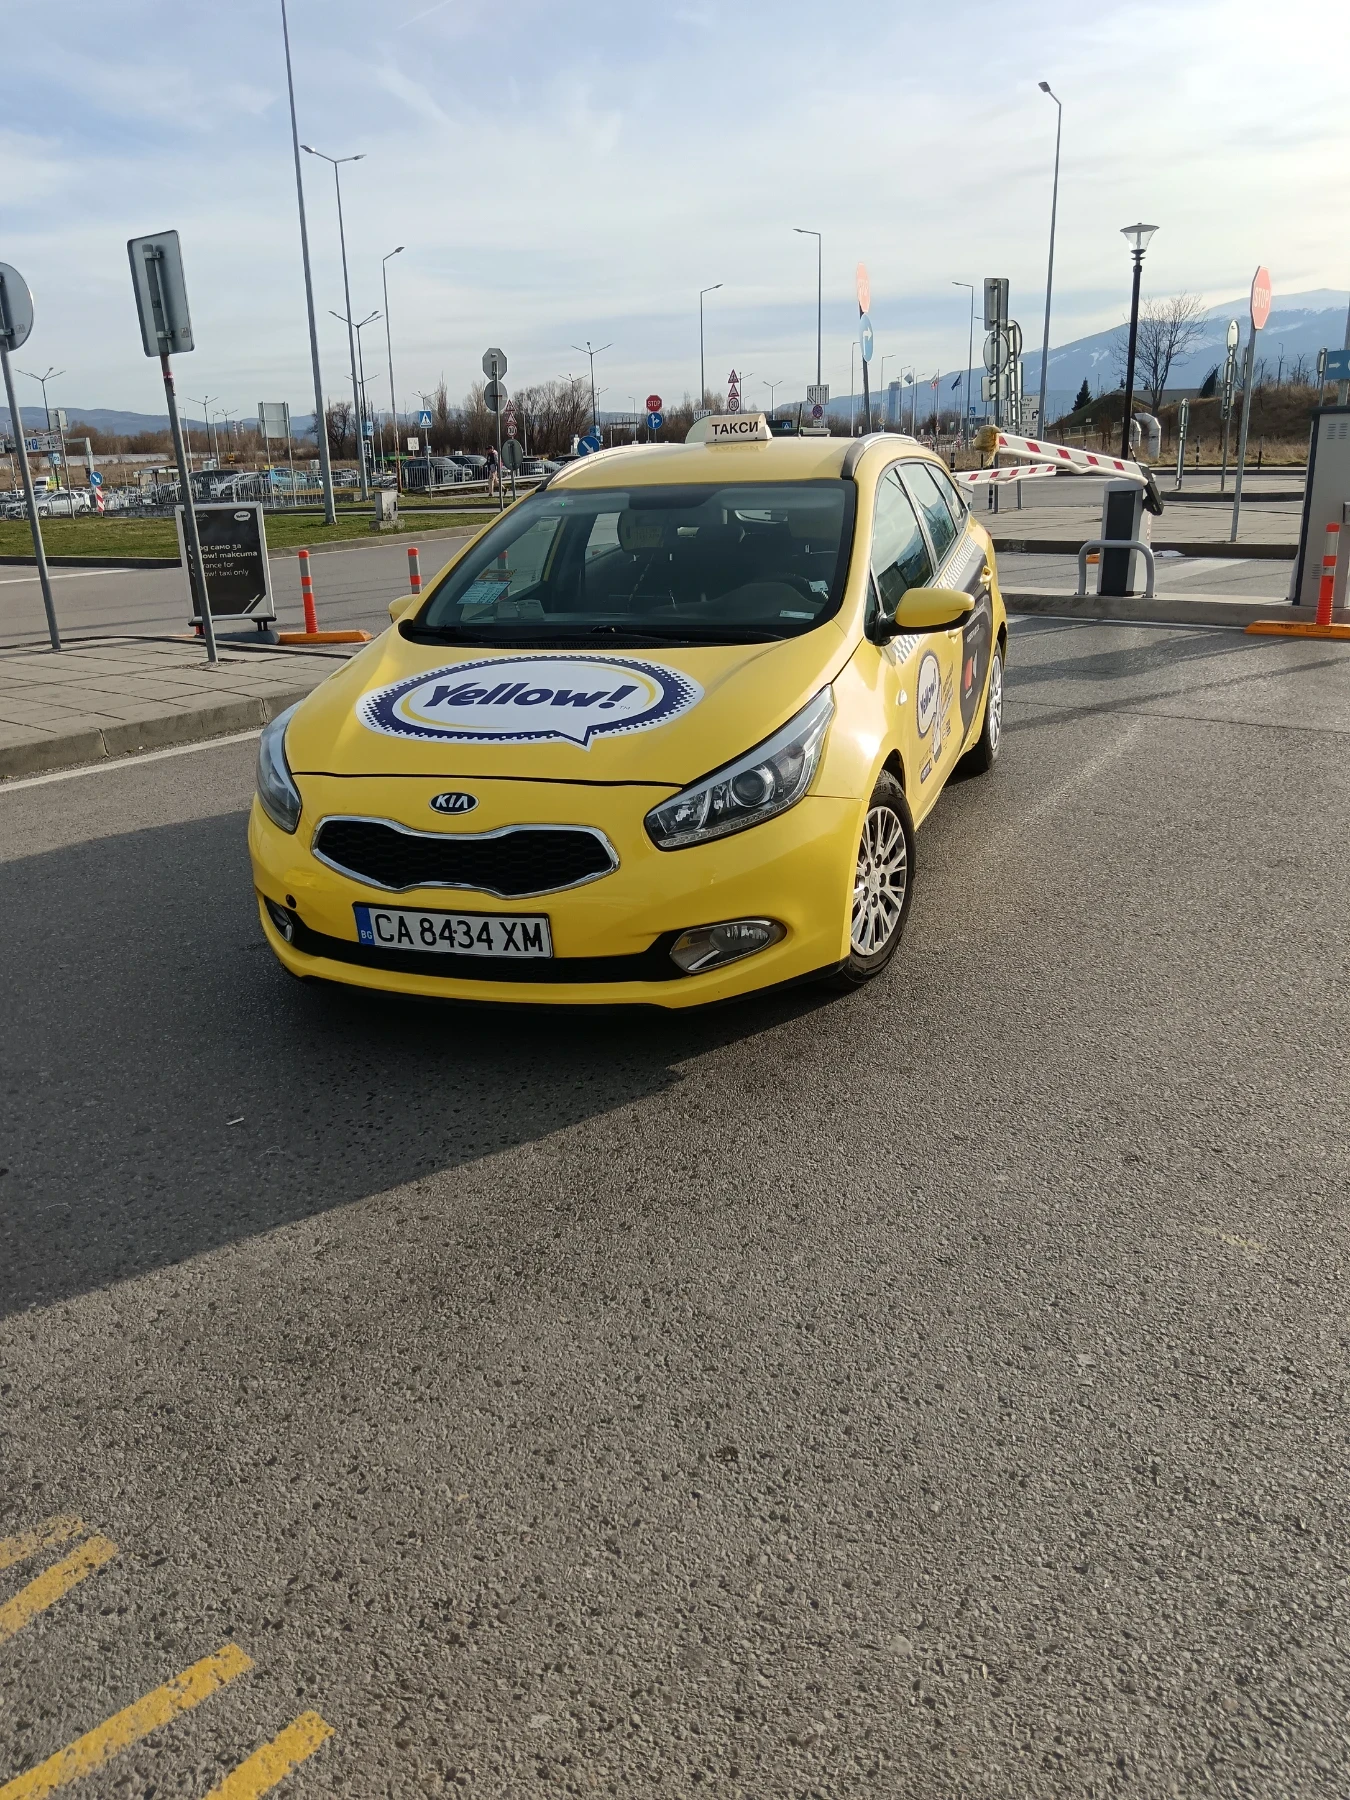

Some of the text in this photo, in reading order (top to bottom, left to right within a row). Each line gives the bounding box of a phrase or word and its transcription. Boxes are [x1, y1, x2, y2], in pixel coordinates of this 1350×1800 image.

[1254, 287, 1269, 309] STOP
[729, 399, 738, 408] 30
[712, 421, 759, 435] ТАКСИ
[219, 569, 233, 577] taxi
[233, 568, 249, 577] only
[423, 682, 639, 709] Yellow!
[435, 794, 469, 809] KIA
[360, 913, 544, 952] BG CA 8434 XM
